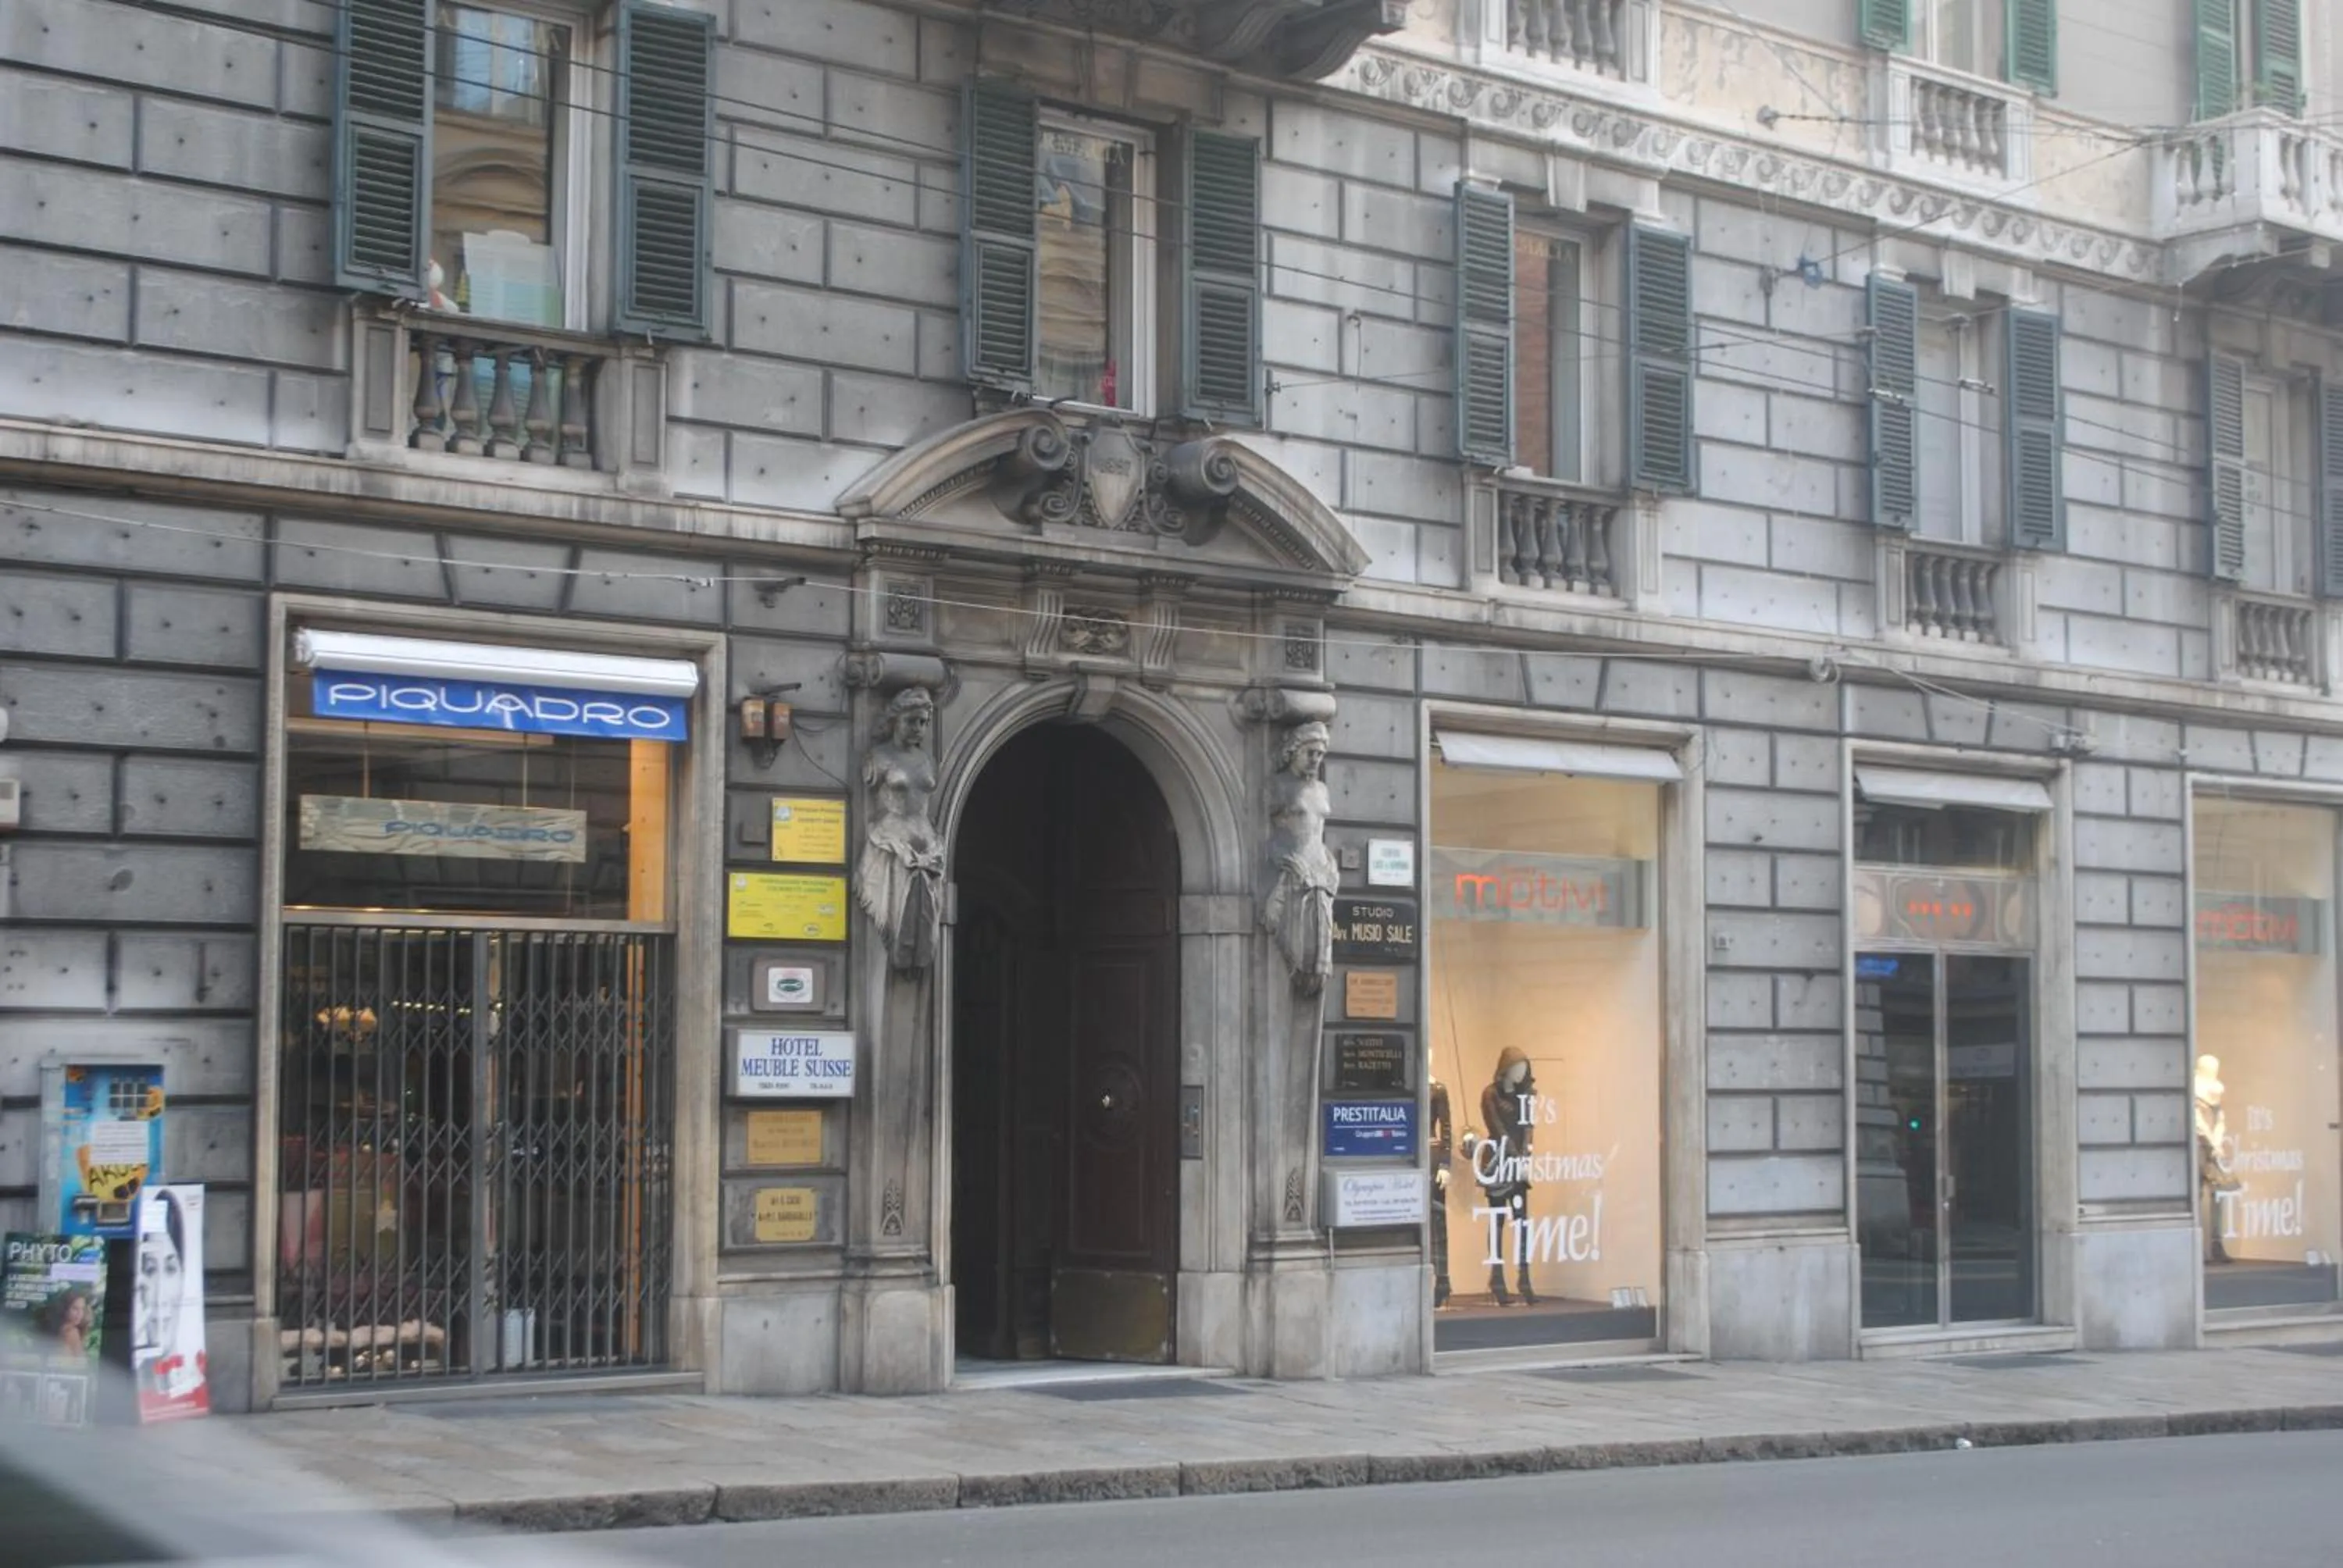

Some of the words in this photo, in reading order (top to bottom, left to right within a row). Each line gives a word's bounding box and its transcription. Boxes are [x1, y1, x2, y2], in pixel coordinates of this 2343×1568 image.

[328, 682, 671, 729] PIQUADRO
[385, 821, 576, 843] PIQUADRO
[1352, 906, 1394, 919] STUDIO
[770, 1037, 823, 1057] HOTEL
[741, 1058, 799, 1078] MEUBLE
[804, 1059, 852, 1078] SUISSE
[1332, 1106, 1407, 1122] PRESTITALIA
[1516, 1093, 1557, 1126] It's
[1472, 1135, 1603, 1185] Christmas
[2214, 1179, 2303, 1238] Time!
[1471, 1191, 1603, 1265] Time!
[9, 1241, 72, 1263] PHYTO
